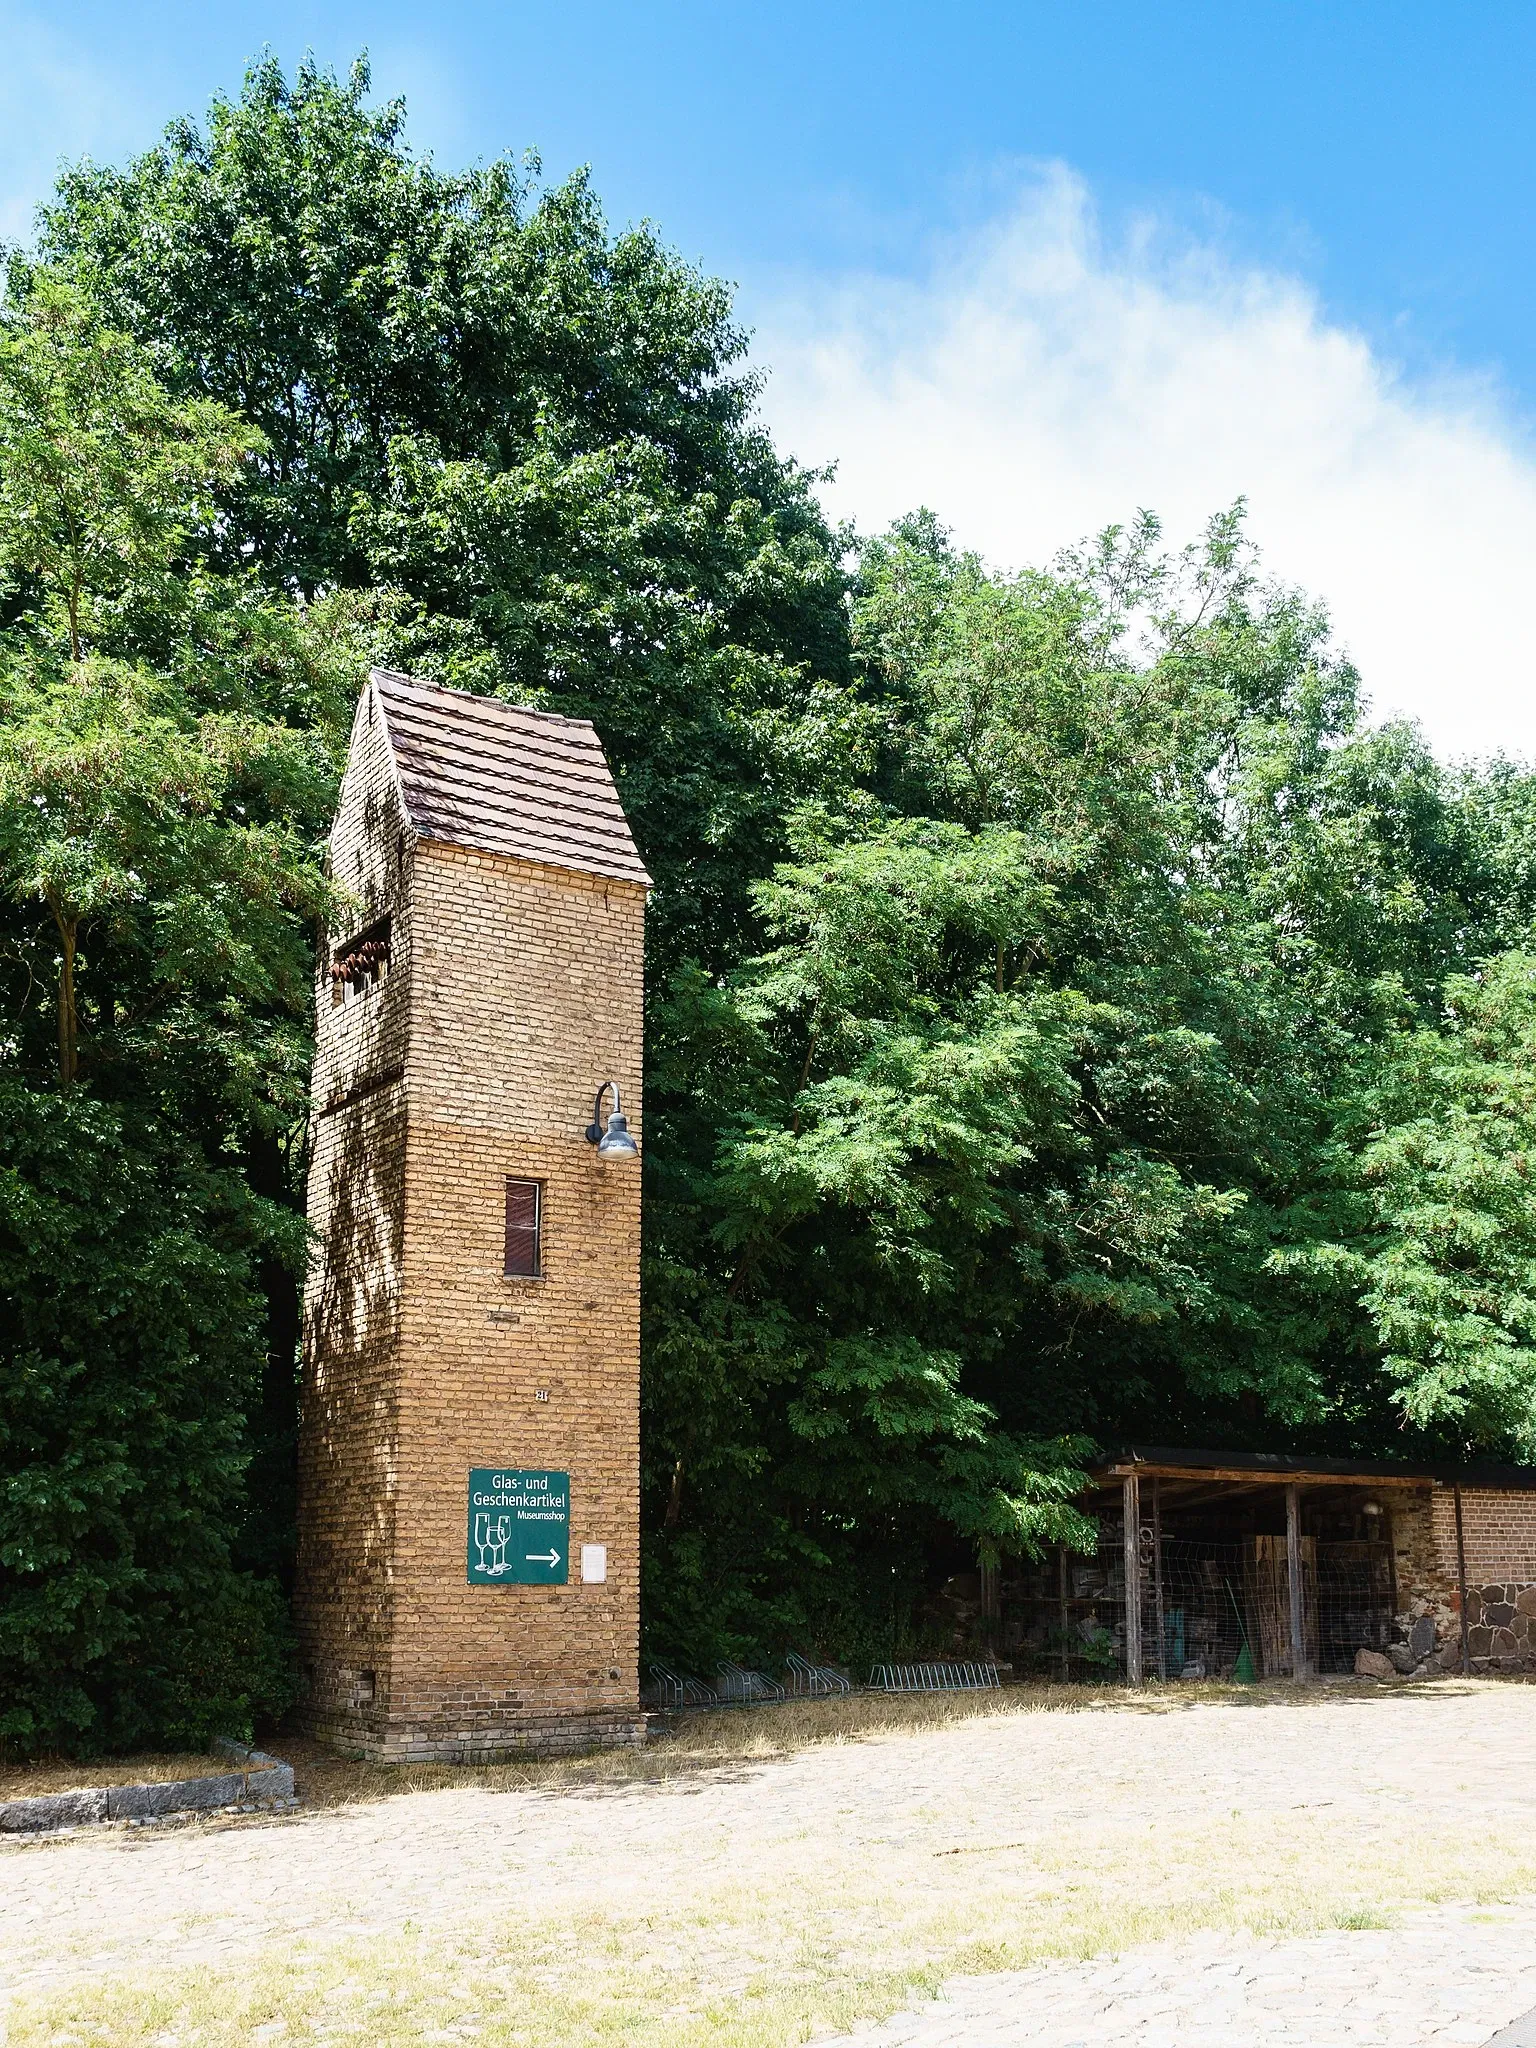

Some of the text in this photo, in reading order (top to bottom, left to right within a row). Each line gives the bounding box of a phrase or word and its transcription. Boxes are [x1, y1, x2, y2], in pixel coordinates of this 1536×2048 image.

[537, 1391, 545, 1399] 21
[492, 1474, 548, 1490] Glas- und
[473, 1491, 565, 1508] Geschenkartikel
[517, 1510, 565, 1522] Museumsshop
